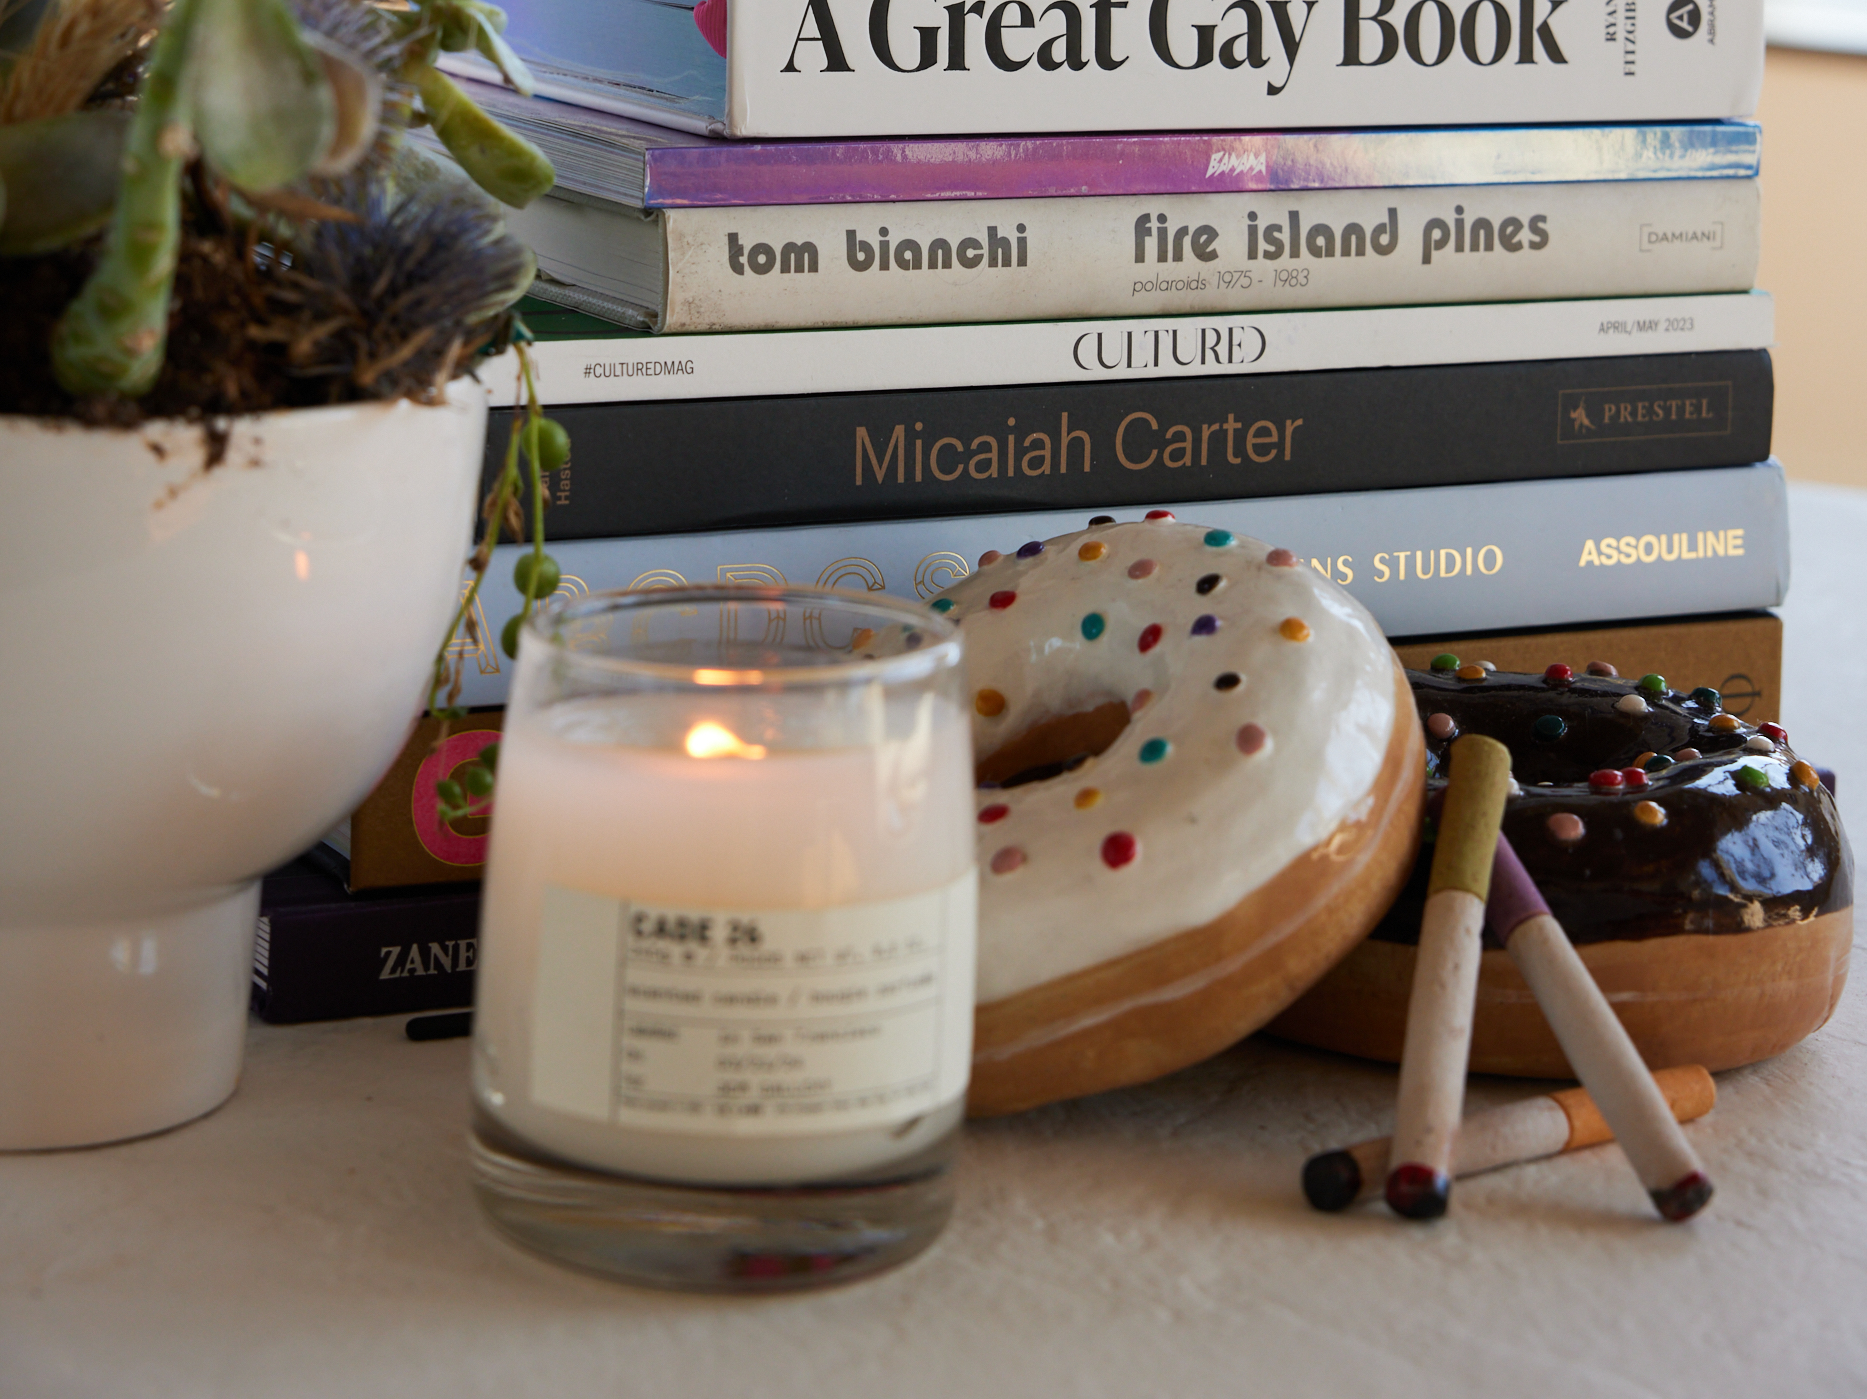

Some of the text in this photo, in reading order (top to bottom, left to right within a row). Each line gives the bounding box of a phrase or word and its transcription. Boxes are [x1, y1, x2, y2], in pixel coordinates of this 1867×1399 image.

[1205, 151, 1267, 179] BANANA
[728, 223, 1028, 276] tom bianchi
[1133, 205, 1549, 265] fire island pines
[1132, 272, 1207, 297] polaroids
[1215, 270, 1253, 290] 1975
[1272, 268, 1310, 288] 1983
[1597, 317, 1695, 336] APRIL/MAY 2023
[1073, 325, 1266, 371] CULTURED
[583, 360, 694, 379] #CULTUREDMAG
[1603, 397, 1714, 425] PRESTEL
[855, 410, 1303, 486] Micaiah Carter
[1373, 544, 1504, 583] STUDIO
[1579, 528, 1745, 568] ASSOULINE
[379, 937, 478, 980] ZANE
